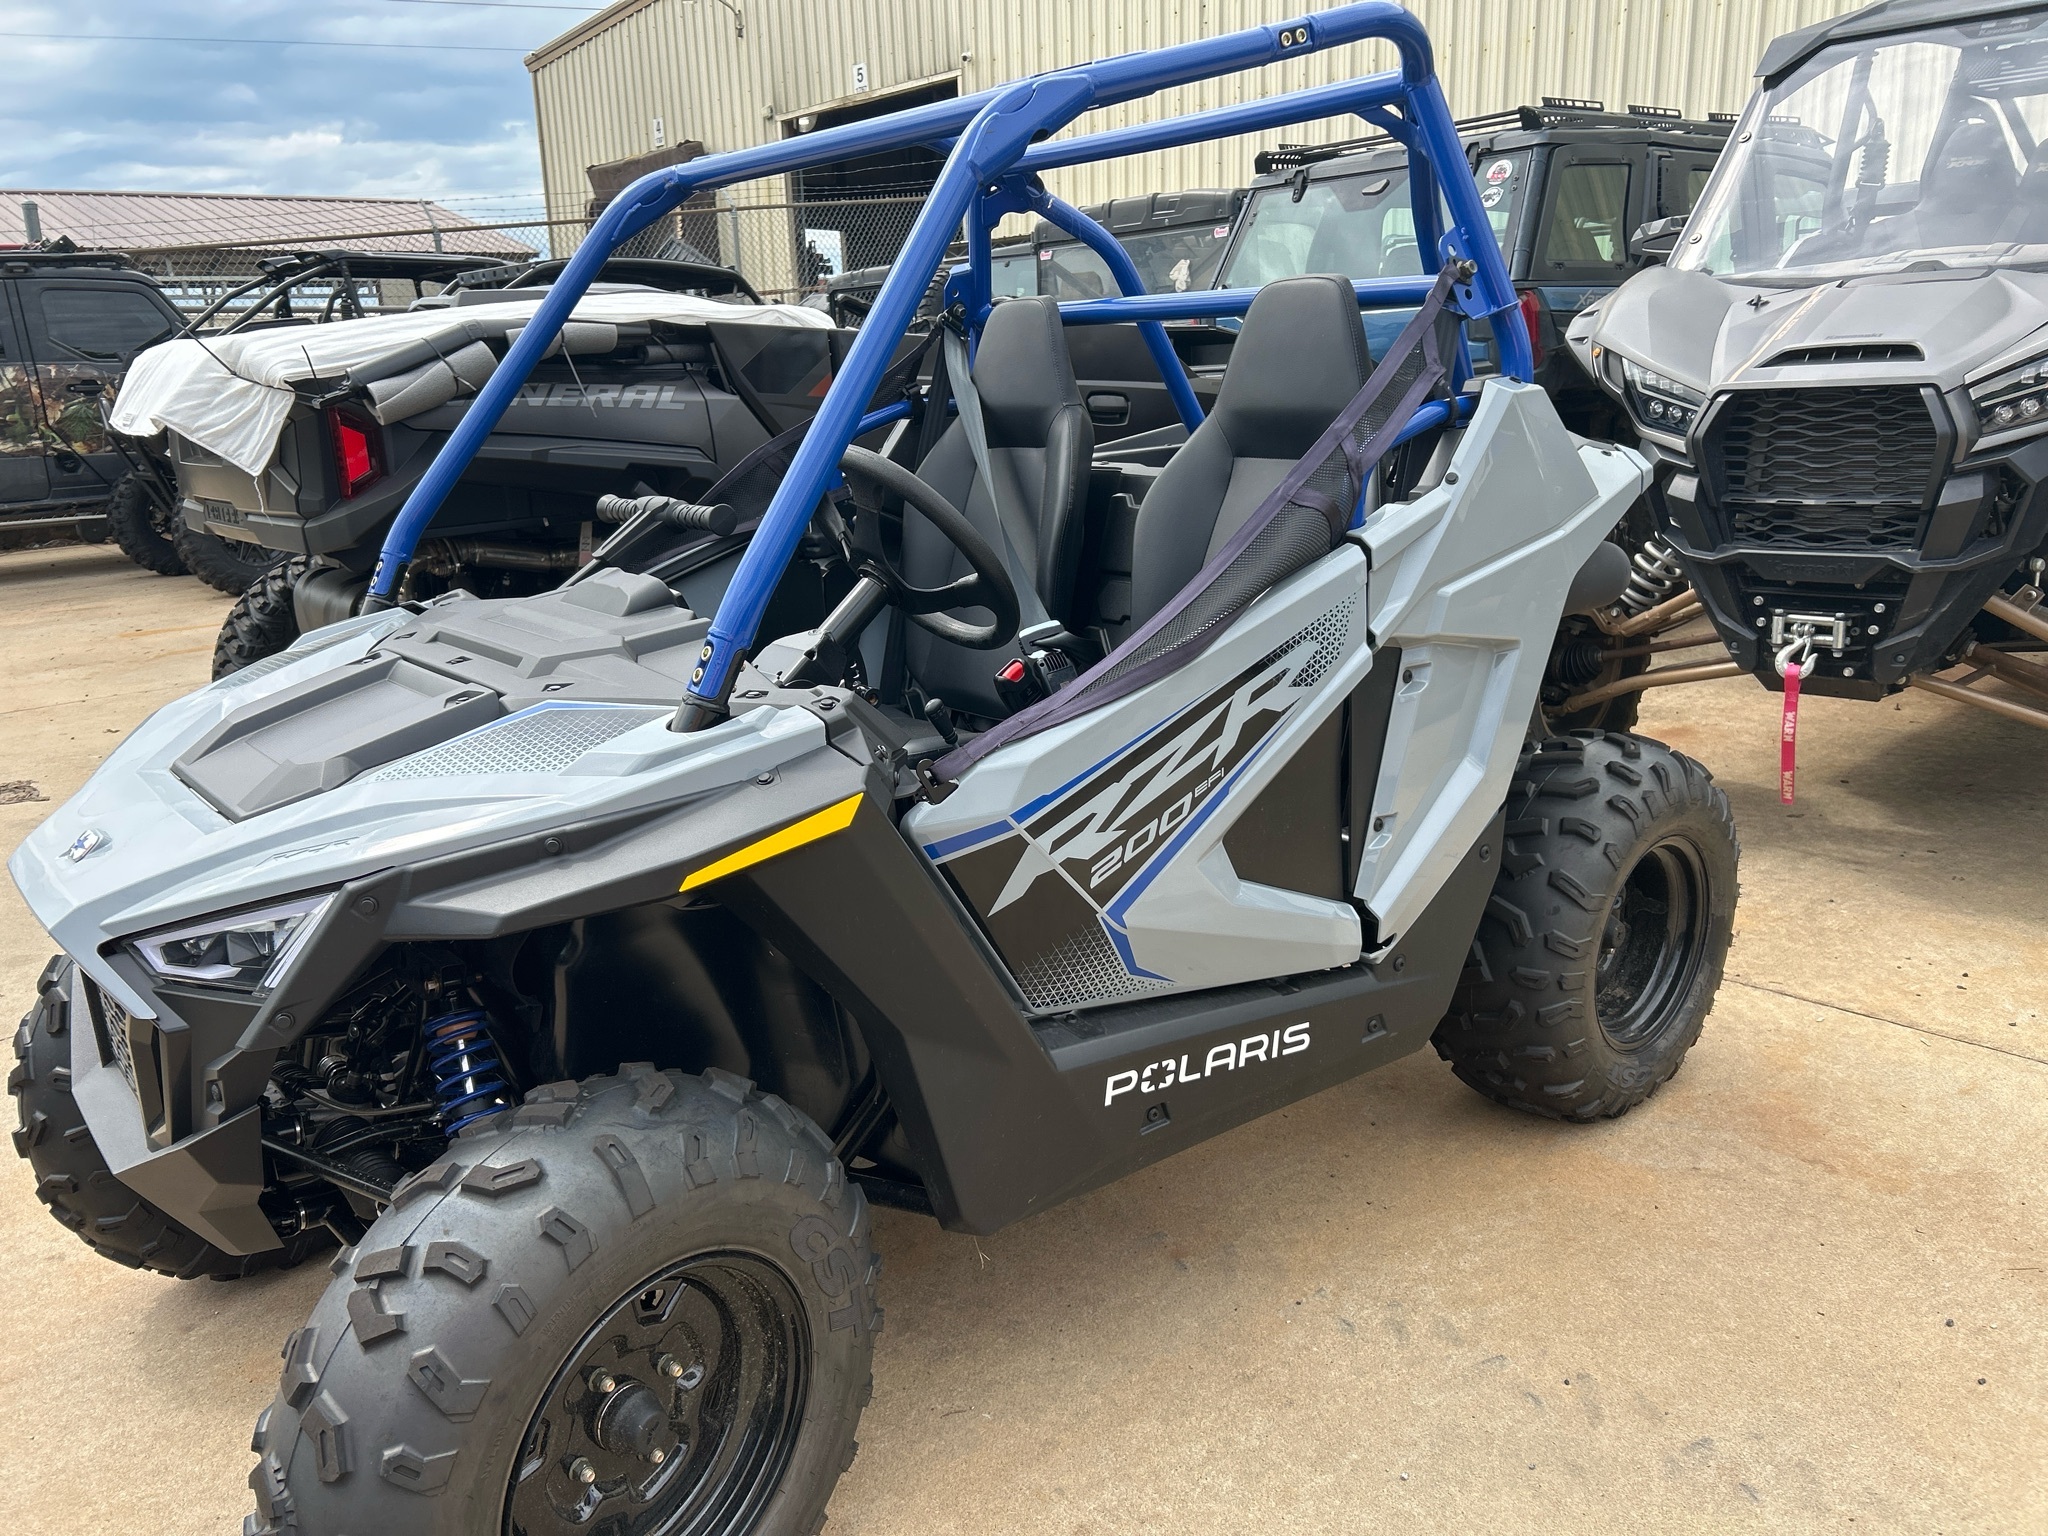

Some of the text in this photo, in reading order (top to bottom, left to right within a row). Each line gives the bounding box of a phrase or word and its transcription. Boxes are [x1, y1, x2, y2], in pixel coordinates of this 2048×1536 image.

[857, 67, 864, 83] 5
[447, 384, 686, 410] NERAL
[1767, 559, 1857, 577] Kawasaki
[1783, 711, 1796, 742] WARN
[987, 640, 1323, 918] RZR
[1783, 769, 1793, 800] WARN
[1090, 767, 1225, 890] 200 EFI
[1104, 1021, 1311, 1107] POLARIS
[1606, 1063, 1652, 1089] CST
[789, 1214, 862, 1338] CST
